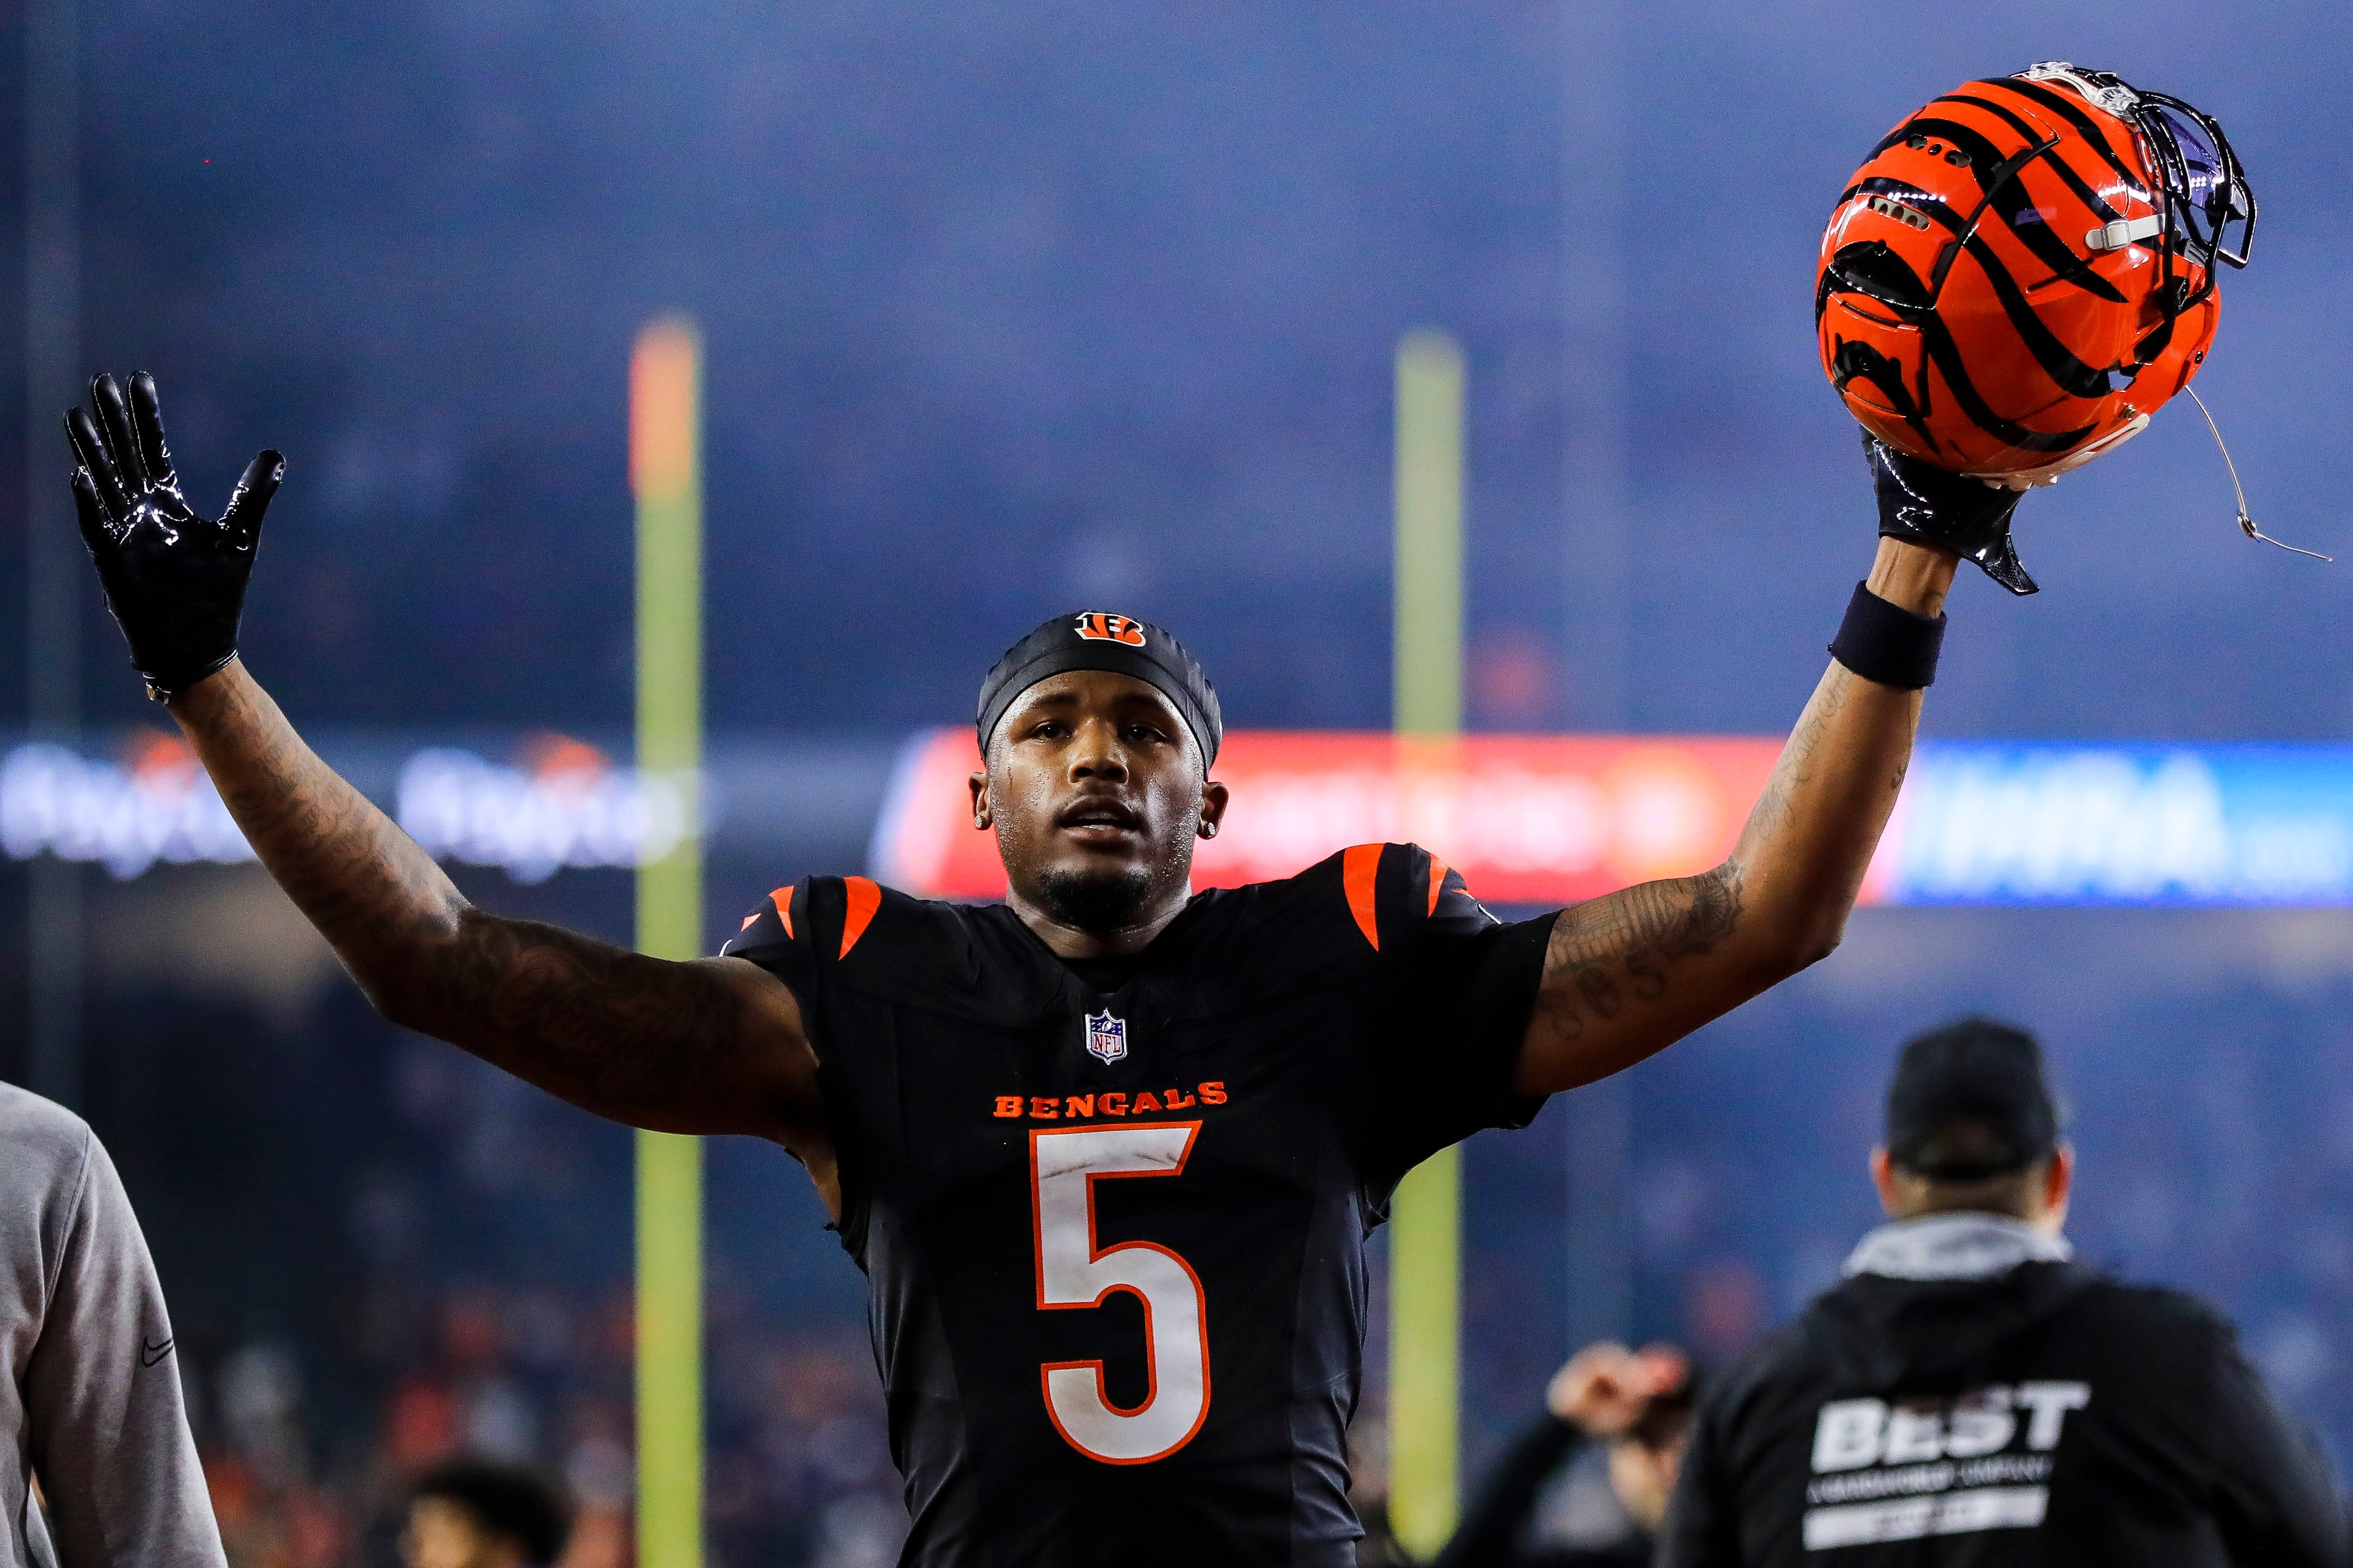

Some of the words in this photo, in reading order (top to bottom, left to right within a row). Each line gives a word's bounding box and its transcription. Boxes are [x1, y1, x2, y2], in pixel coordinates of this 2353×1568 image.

[1093, 1033, 1121, 1055] NFL
[993, 1082, 1228, 1119] BENGALS
[1029, 1120, 1211, 1465] 5
[1810, 1379, 2092, 1474] BEST
